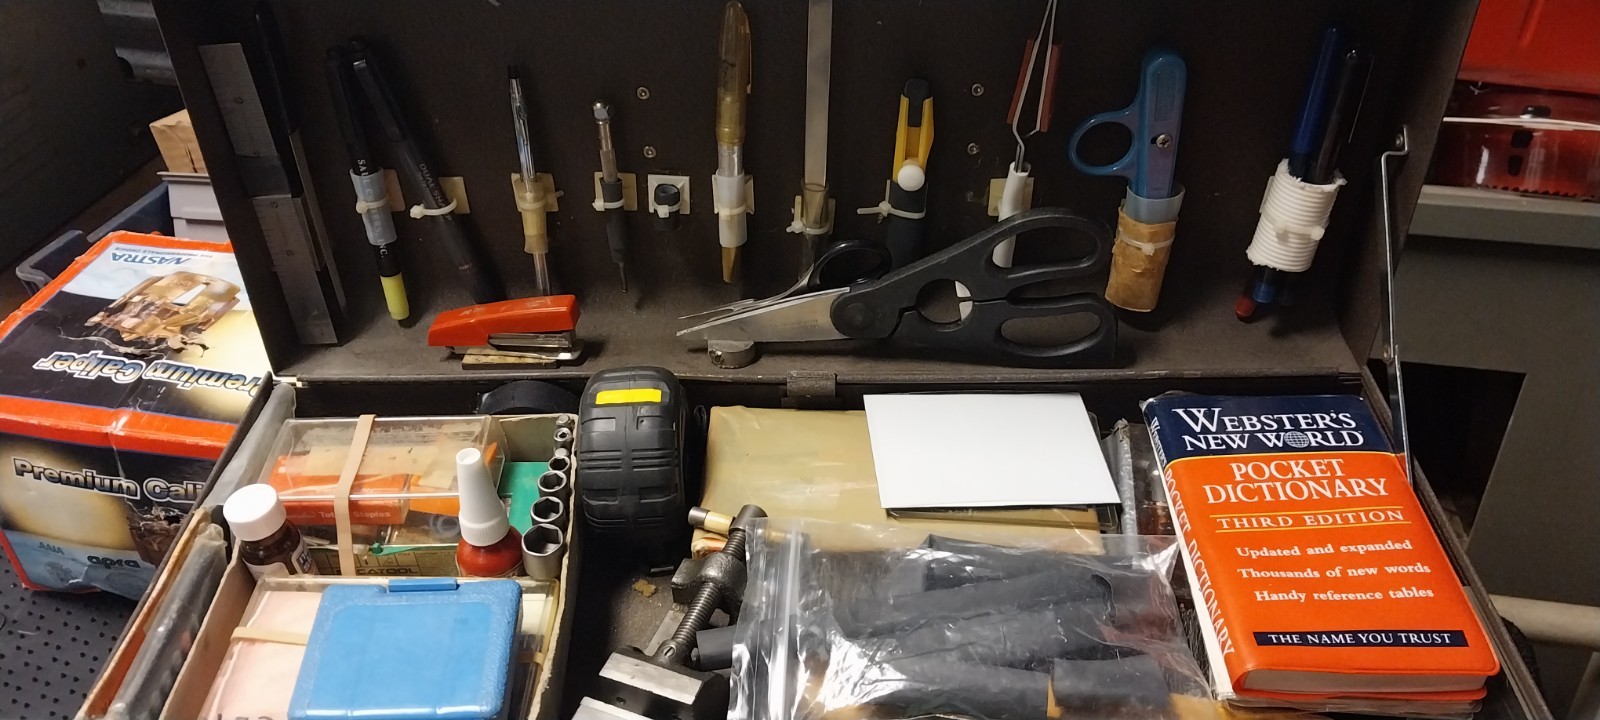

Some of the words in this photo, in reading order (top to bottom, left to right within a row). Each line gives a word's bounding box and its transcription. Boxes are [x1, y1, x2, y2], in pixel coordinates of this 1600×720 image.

[420, 163, 436, 189] DUAL
[433, 190, 453, 221] SHAP
[111, 252, 191, 266] NASTRA
[34, 351, 145, 382] Caliper
[1172, 407, 1357, 434] WEBSTER'S
[1182, 433, 1250, 451] NEW
[1254, 430, 1365, 449] WORLD
[1230, 458, 1347, 481] POCKET
[14, 458, 139, 498] Premium
[143, 477, 206, 503] Cali
[1202, 478, 1390, 504] DICTIONARY
[1164, 468, 1192, 533] POCKET
[1216, 515, 1293, 529] THIRD
[1303, 510, 1404, 526] EDITION
[1236, 545, 1301, 559] Updated
[1306, 543, 1335, 556] and
[1340, 540, 1413, 554] expanded
[86, 555, 141, 569] apra
[336, 567, 418, 575] CATOOL
[1237, 568, 1321, 579] Thousands
[1325, 566, 1342, 578] of
[1347, 566, 1379, 577] new
[1385, 562, 1431, 574] words
[1188, 538, 1236, 658] DICTIONARY
[1254, 590, 1307, 603] Handy
[1313, 589, 1384, 601] reference
[1388, 587, 1435, 599] tables
[1268, 634, 1302, 644] THE
[1306, 634, 1355, 644] NAME
[1356, 633, 1394, 643] YOU
[1397, 633, 1451, 644] TRUST
